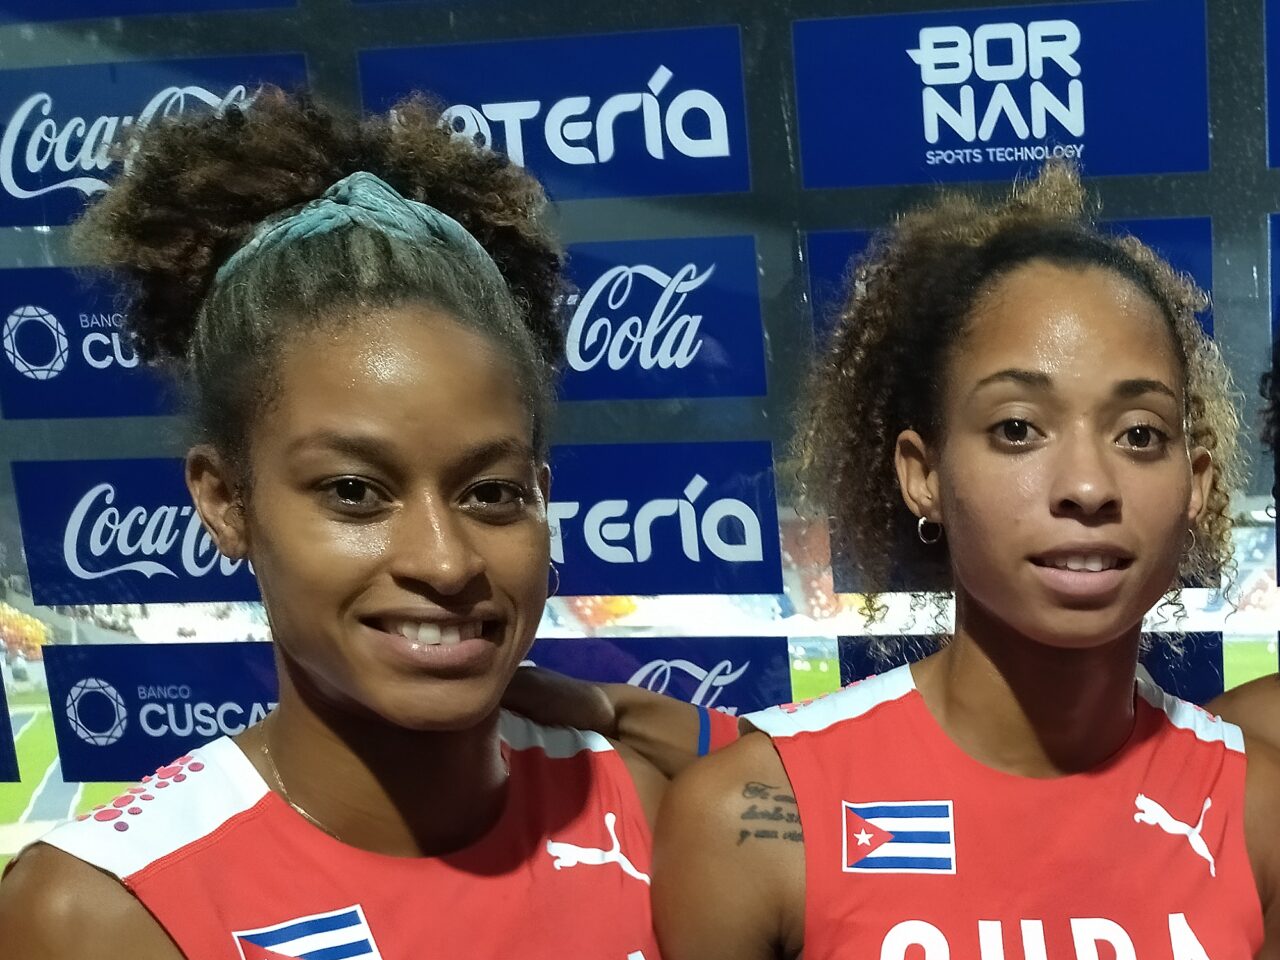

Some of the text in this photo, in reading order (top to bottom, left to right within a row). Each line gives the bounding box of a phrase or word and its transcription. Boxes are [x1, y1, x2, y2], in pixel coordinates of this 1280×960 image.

[906, 20, 1081, 85] BOR
[922, 79, 1085, 144] NAN
[925, 144, 1085, 165] SPORTS TECHNOLOGY
[79, 313, 128, 328] BANC
[137, 685, 191, 699] BANCO
[139, 702, 279, 737] CUSCA
